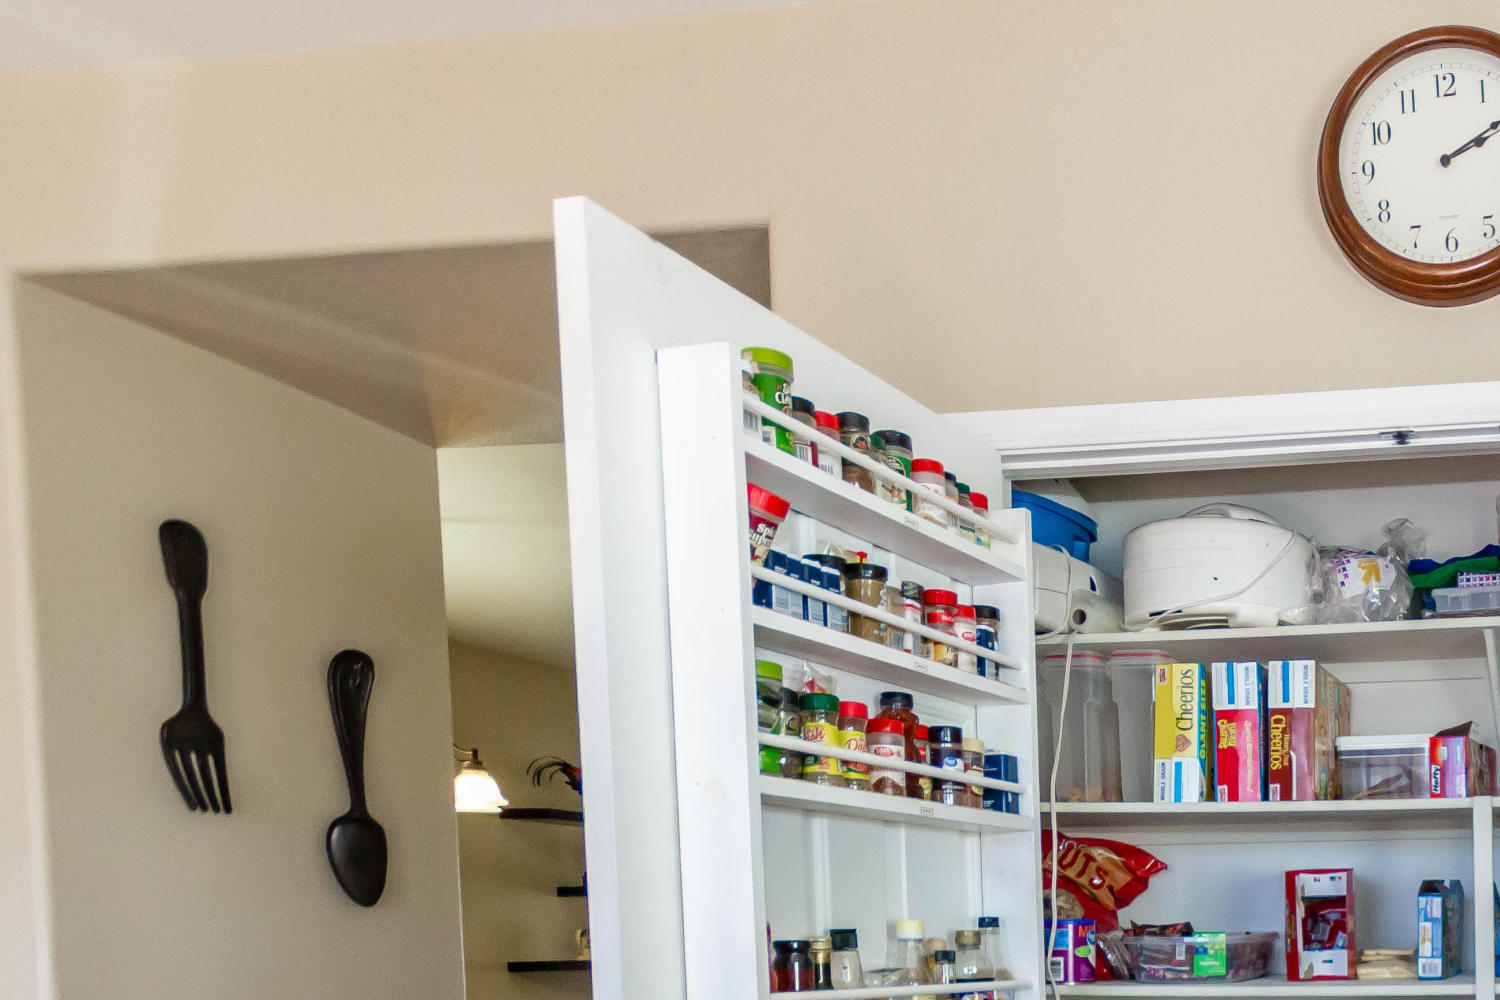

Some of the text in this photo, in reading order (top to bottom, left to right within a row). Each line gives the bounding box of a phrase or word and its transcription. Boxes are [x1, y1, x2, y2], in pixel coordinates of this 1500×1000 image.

[1433, 72, 1457, 98] 12
[1478, 79, 1487, 103] 1
[1400, 89, 1417, 114] 11
[1371, 120, 1392, 145] 10
[1361, 160, 1375, 185] 9
[1378, 199, 1390, 223] 8
[1409, 225, 1422, 249] 7
[1483, 214, 1496, 239] 5
[1445, 227, 1459, 253] 6
[1175, 668, 1194, 731] Cheerios
[1270, 714, 1286, 770] Cheerios
[1432, 766, 1441, 792] Hefty
